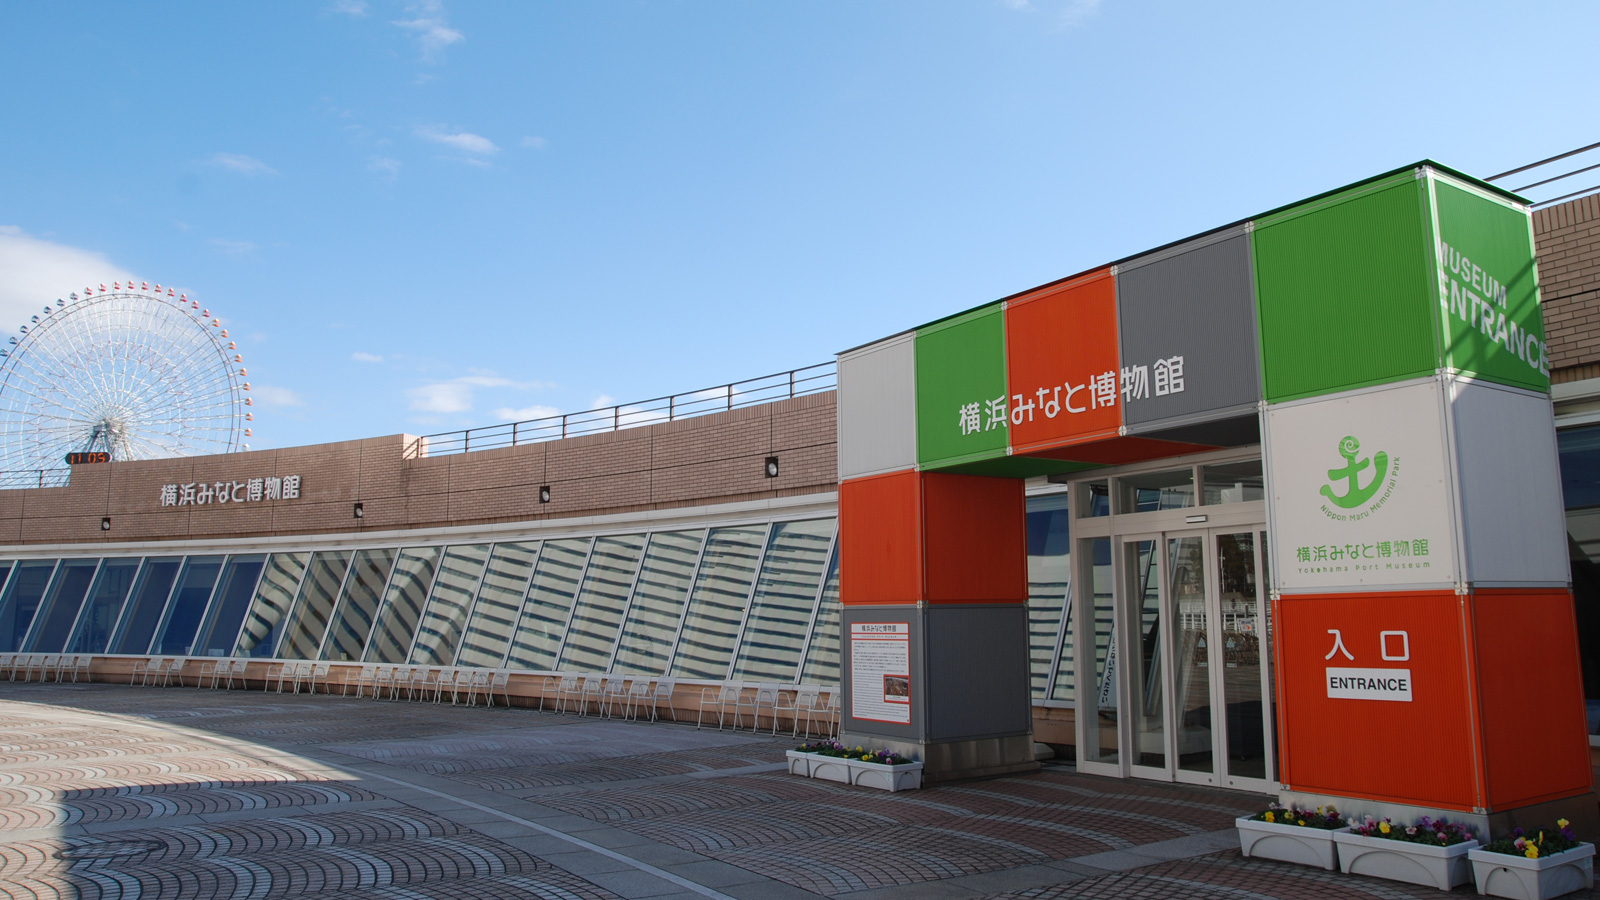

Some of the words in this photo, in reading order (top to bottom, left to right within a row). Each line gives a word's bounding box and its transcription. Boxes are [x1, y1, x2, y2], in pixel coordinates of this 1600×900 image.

[1437, 239, 1507, 310] MUSEUM
[1437, 269, 1550, 378] ENTRANCE
[958, 355, 1186, 436] 横浜みなと博物館
[159, 475, 300, 507] 横浜みなと博物館
[1320, 504, 1347, 521] Nippon
[1349, 510, 1369, 521] Maru
[1369, 478, 1396, 513] Memorial
[1392, 456, 1400, 476] Park
[1296, 539, 1429, 562] 横浜みなと博物館
[1298, 565, 1348, 574] Yokohama
[1355, 563, 1379, 571] Port
[1386, 561, 1430, 570] Museum
[1325, 629, 1410, 661] 入口
[1330, 677, 1407, 691] ENTRANCE
